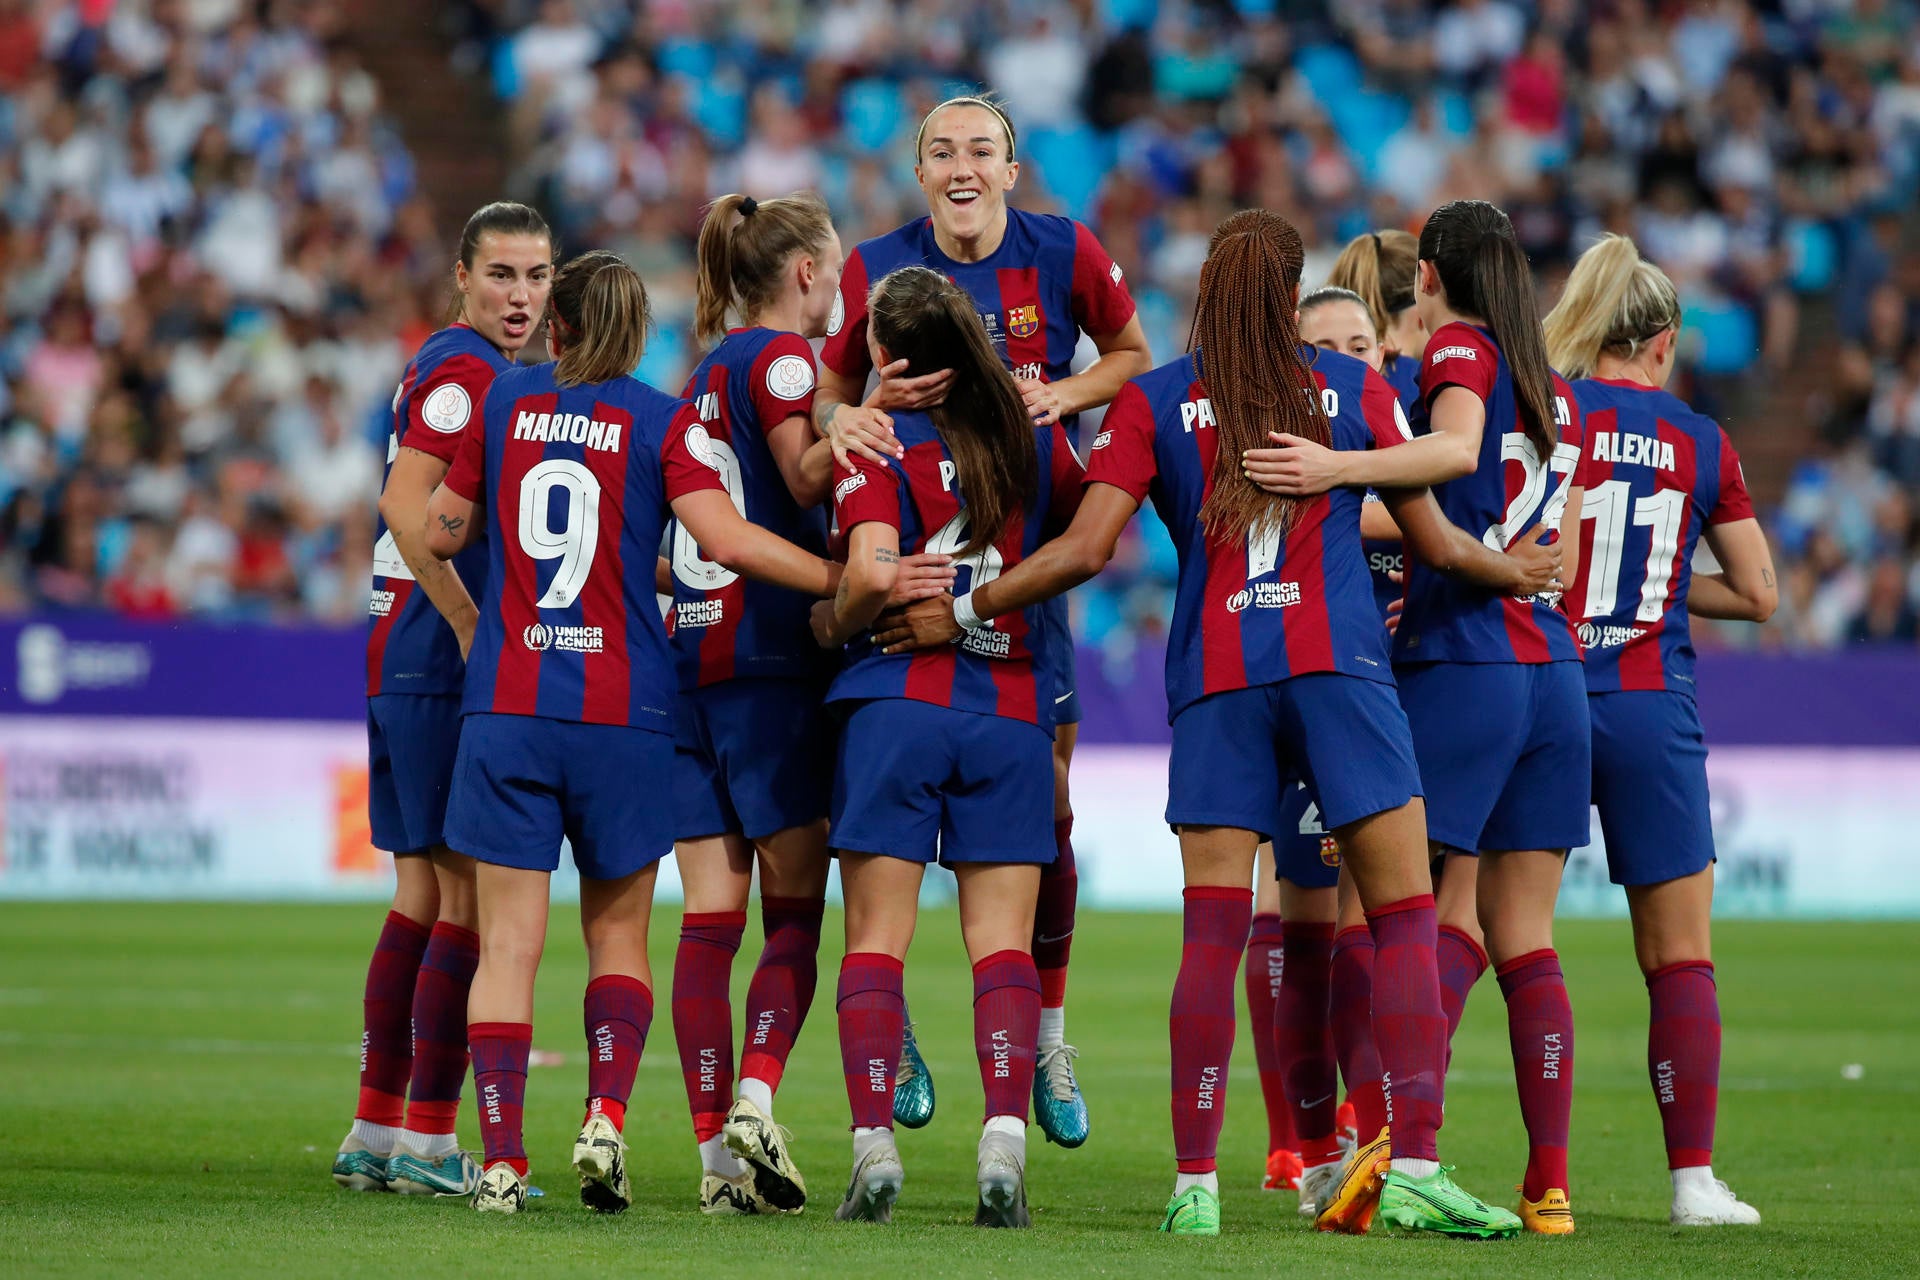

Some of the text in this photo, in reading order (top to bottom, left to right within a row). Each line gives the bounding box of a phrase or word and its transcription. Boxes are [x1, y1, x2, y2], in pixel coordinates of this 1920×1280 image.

[1008, 362, 1041, 380] tify
[1433, 348, 1476, 363] BIMBO
[514, 411, 622, 453] MARIONA
[1592, 431, 1675, 472] ALEXIA
[518, 459, 601, 609] 9
[1580, 479, 1688, 622] 11
[371, 590, 396, 603] NHCR
[1254, 582, 1299, 593] UNHCR
[1255, 591, 1301, 604] ACNUR
[370, 600, 392, 612] CNUR
[677, 599, 723, 614] UNHCR
[678, 609, 723, 624] ACNUR
[555, 626, 603, 638] UNHCR
[555, 636, 603, 648] ACNUR
[962, 635, 1009, 655] ACNUR
[966, 626, 1010, 644] UNHCR
[595, 1024, 615, 1063] BARÇA
[753, 1009, 776, 1045] BARÇA
[700, 1048, 718, 1092] BARÇA
[992, 1029, 1012, 1078] BARÇA
[1544, 1033, 1563, 1080] BARÇA
[869, 1058, 888, 1092] BARÇA
[1197, 1066, 1219, 1110] BARÇA
[1657, 1060, 1676, 1103] BARÇA
[484, 1084, 502, 1125] BARÇA
